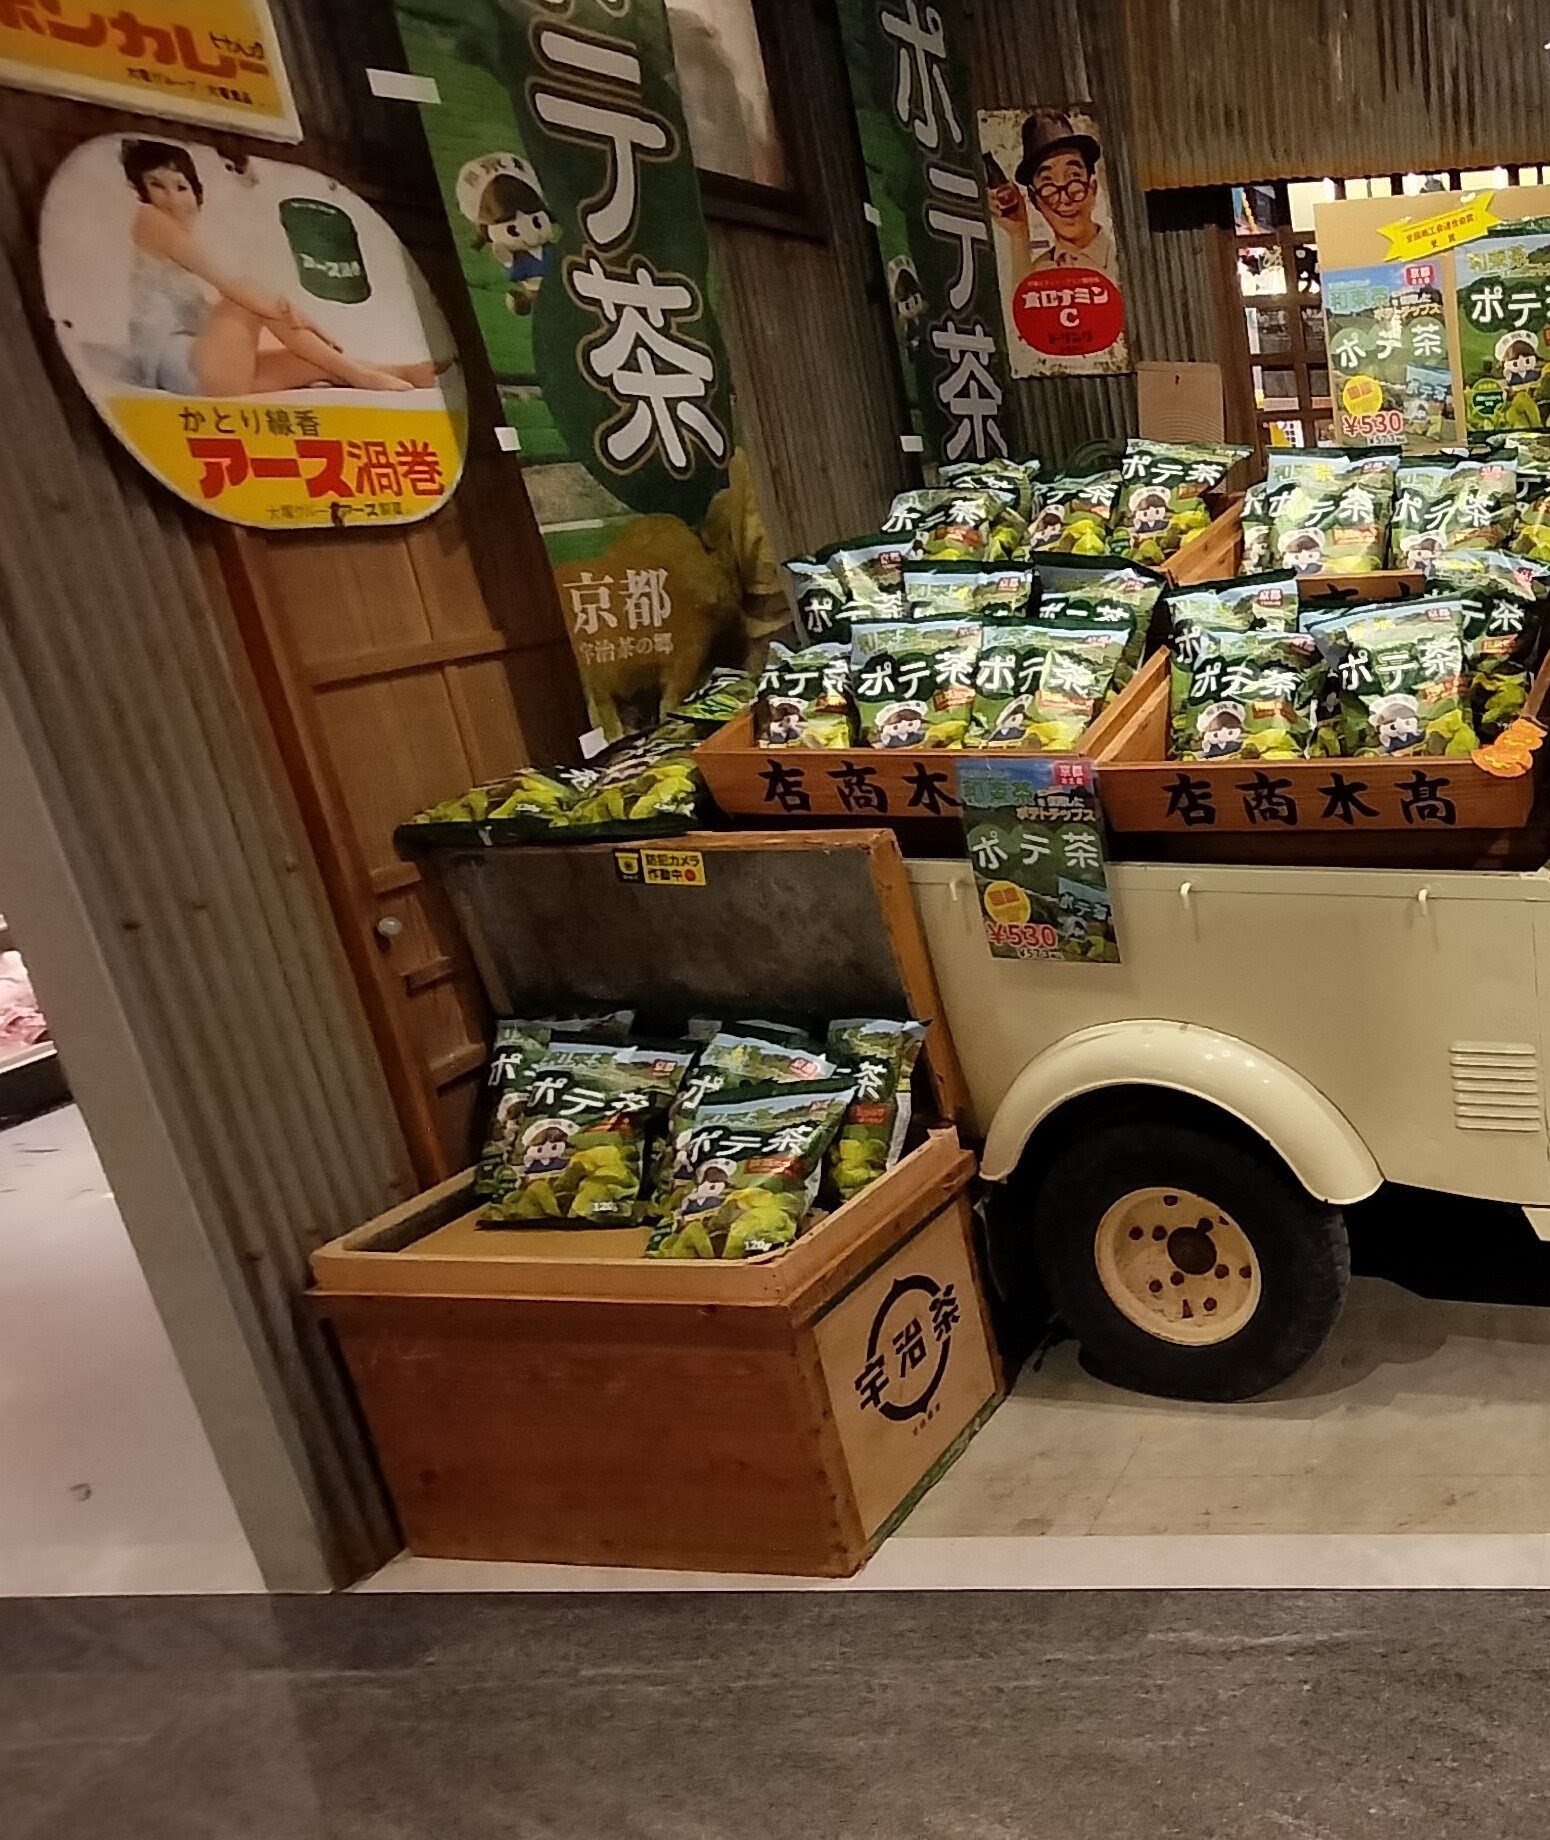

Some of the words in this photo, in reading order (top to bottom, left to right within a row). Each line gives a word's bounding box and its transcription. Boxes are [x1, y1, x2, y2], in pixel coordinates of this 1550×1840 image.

[534, 0, 729, 469] テ茶
[1060, 308, 1080, 328] C
[1335, 322, 1442, 368] ポテ茶
[179, 406, 321, 438] かとり線香
[1343, 411, 1402, 436] ¥530
[185, 437, 446, 500] アース渦巻
[1121, 454, 1227, 487] ポテ茶
[562, 567, 673, 635] 京都
[858, 650, 977, 698] ポテ茶
[976, 652, 1092, 696] ポテ茶
[1340, 638, 1462, 693] ポテ茶
[972, 831, 1100, 870] ポテ茶
[987, 922, 1057, 948] ¥530
[526, 1077, 650, 1117] ポテ茶
[690, 1124, 813, 1164] ポテ茶
